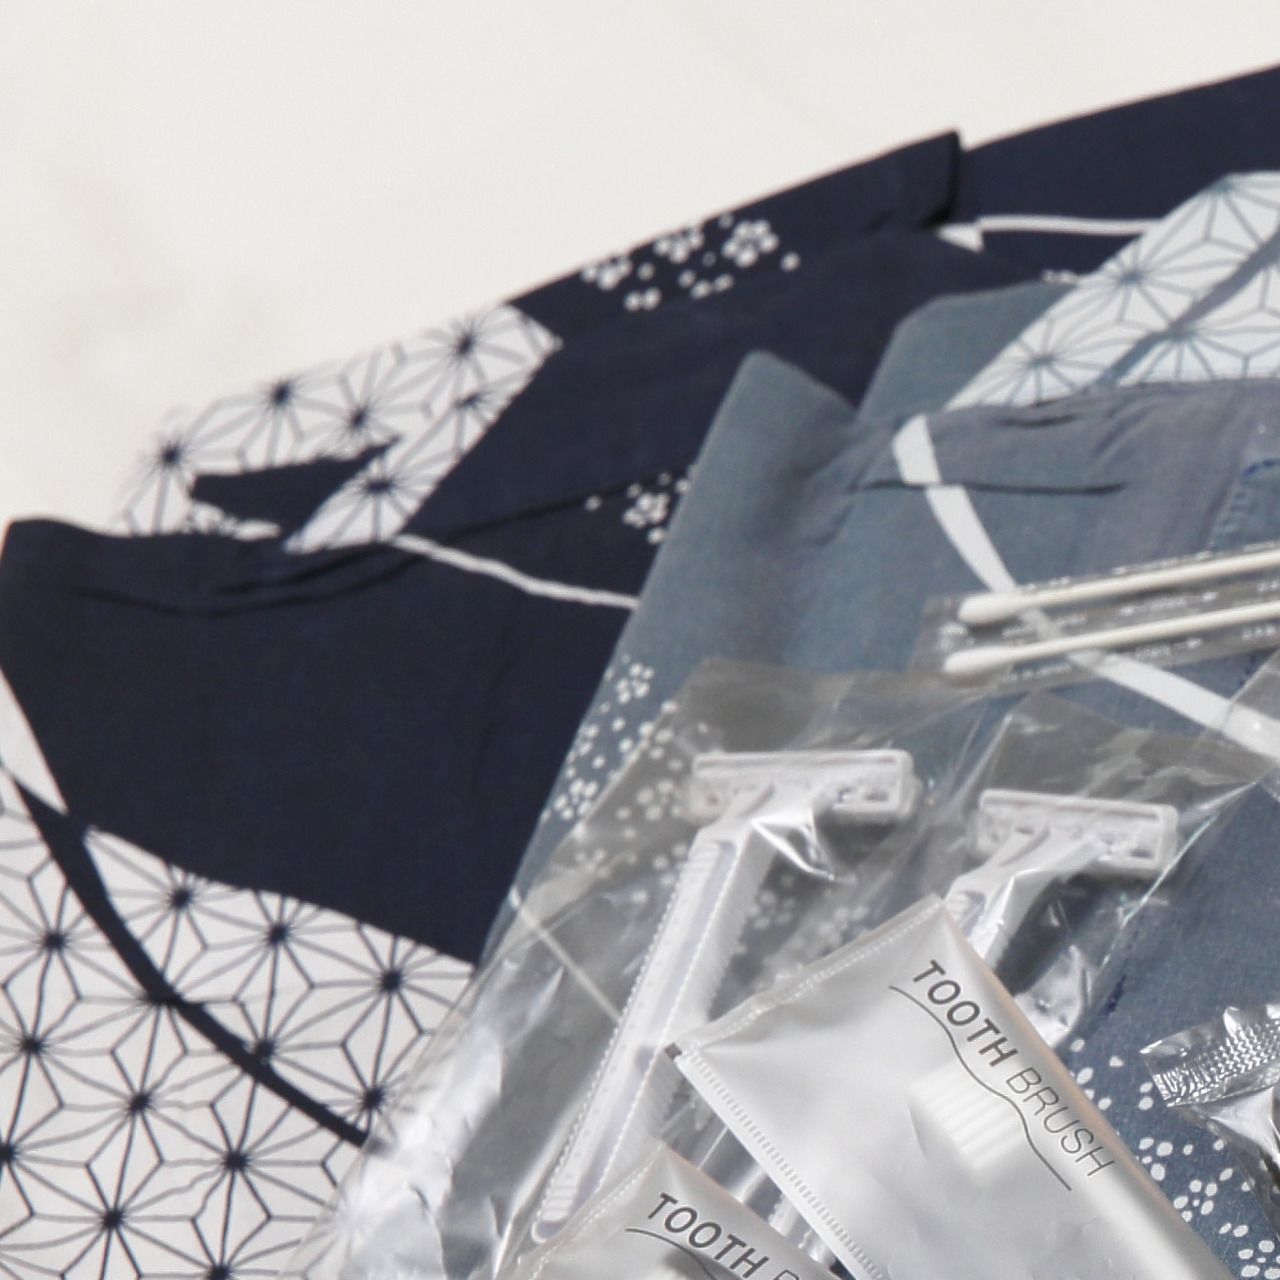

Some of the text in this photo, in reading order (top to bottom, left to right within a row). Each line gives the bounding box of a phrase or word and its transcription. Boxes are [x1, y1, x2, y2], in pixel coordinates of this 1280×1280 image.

[911, 959, 1117, 1178] TOOTH BRUSH
[645, 1192, 769, 1280] TOOTH
